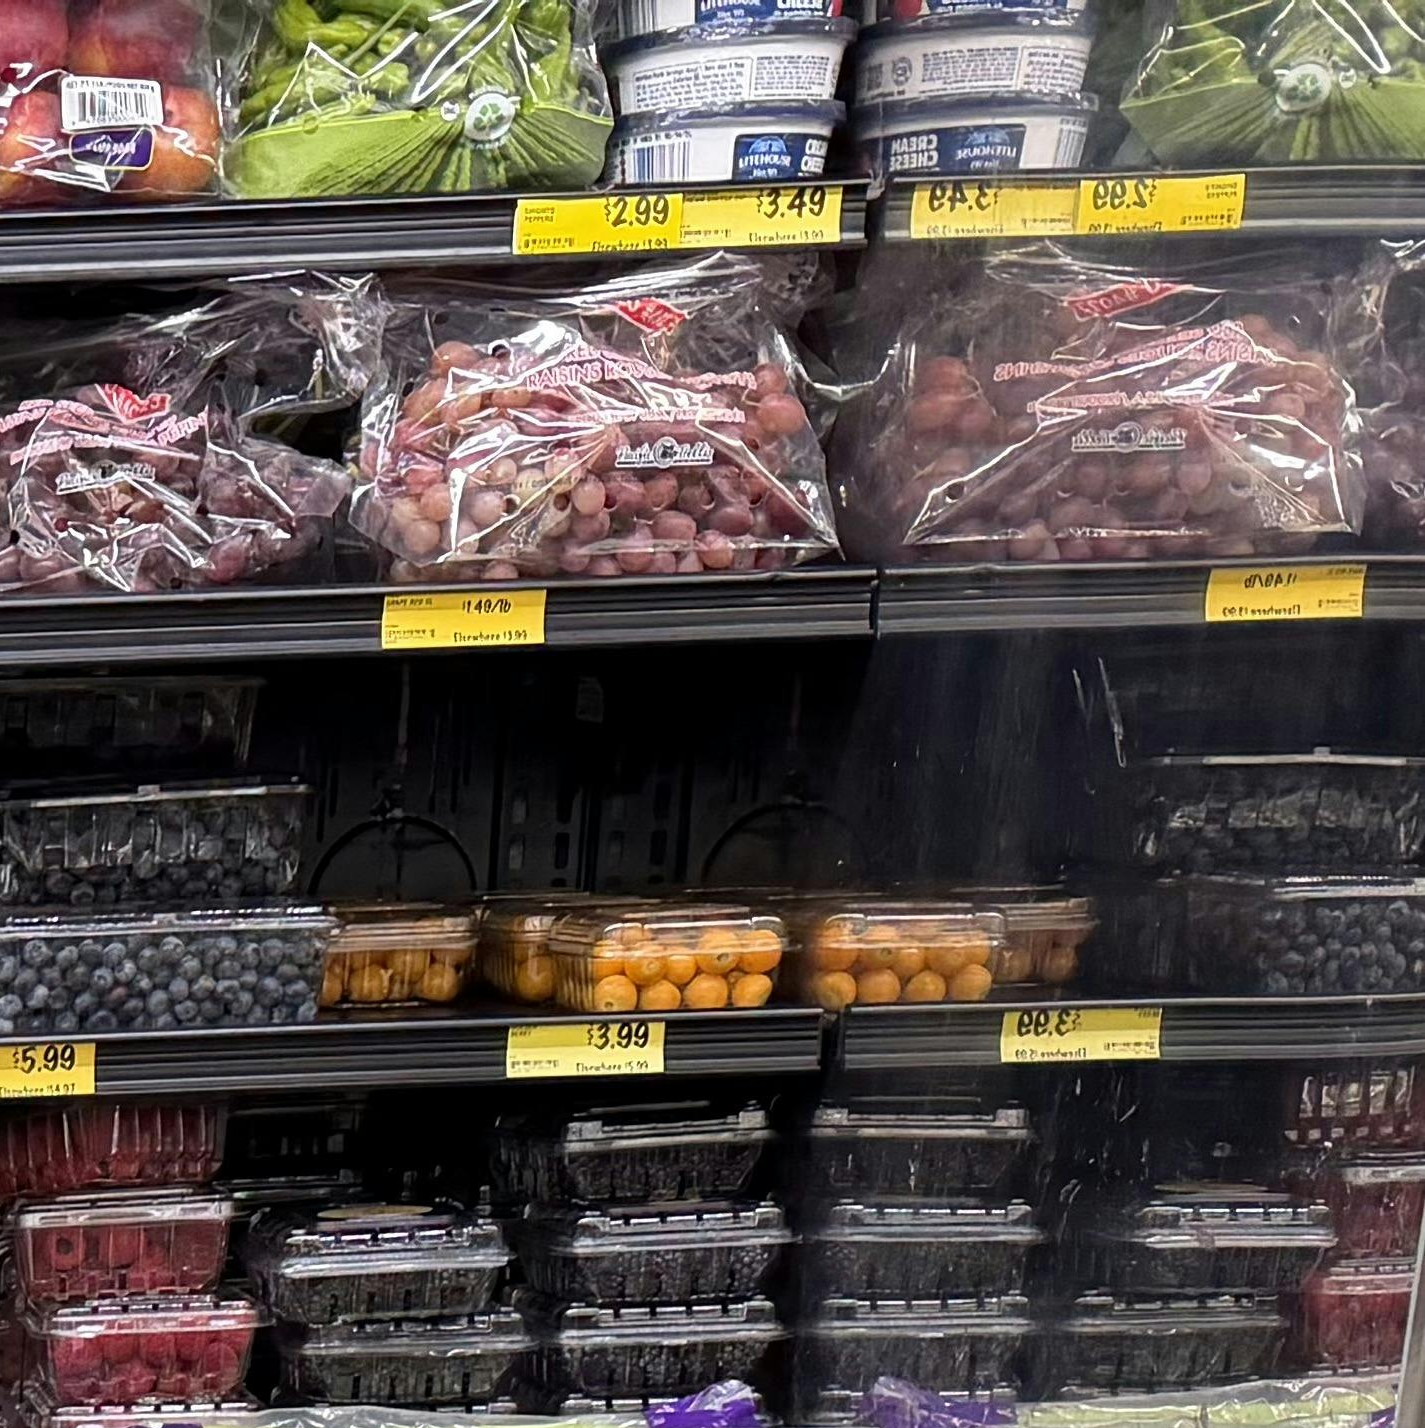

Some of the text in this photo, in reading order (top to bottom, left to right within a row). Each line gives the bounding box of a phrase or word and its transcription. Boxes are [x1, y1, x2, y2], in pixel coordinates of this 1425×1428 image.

[606, 193, 670, 228] $2.99
[756, 186, 825, 218] $3.49
[587, 1021, 650, 1051] $3.99
[13, 1043, 76, 1074] $5.99
